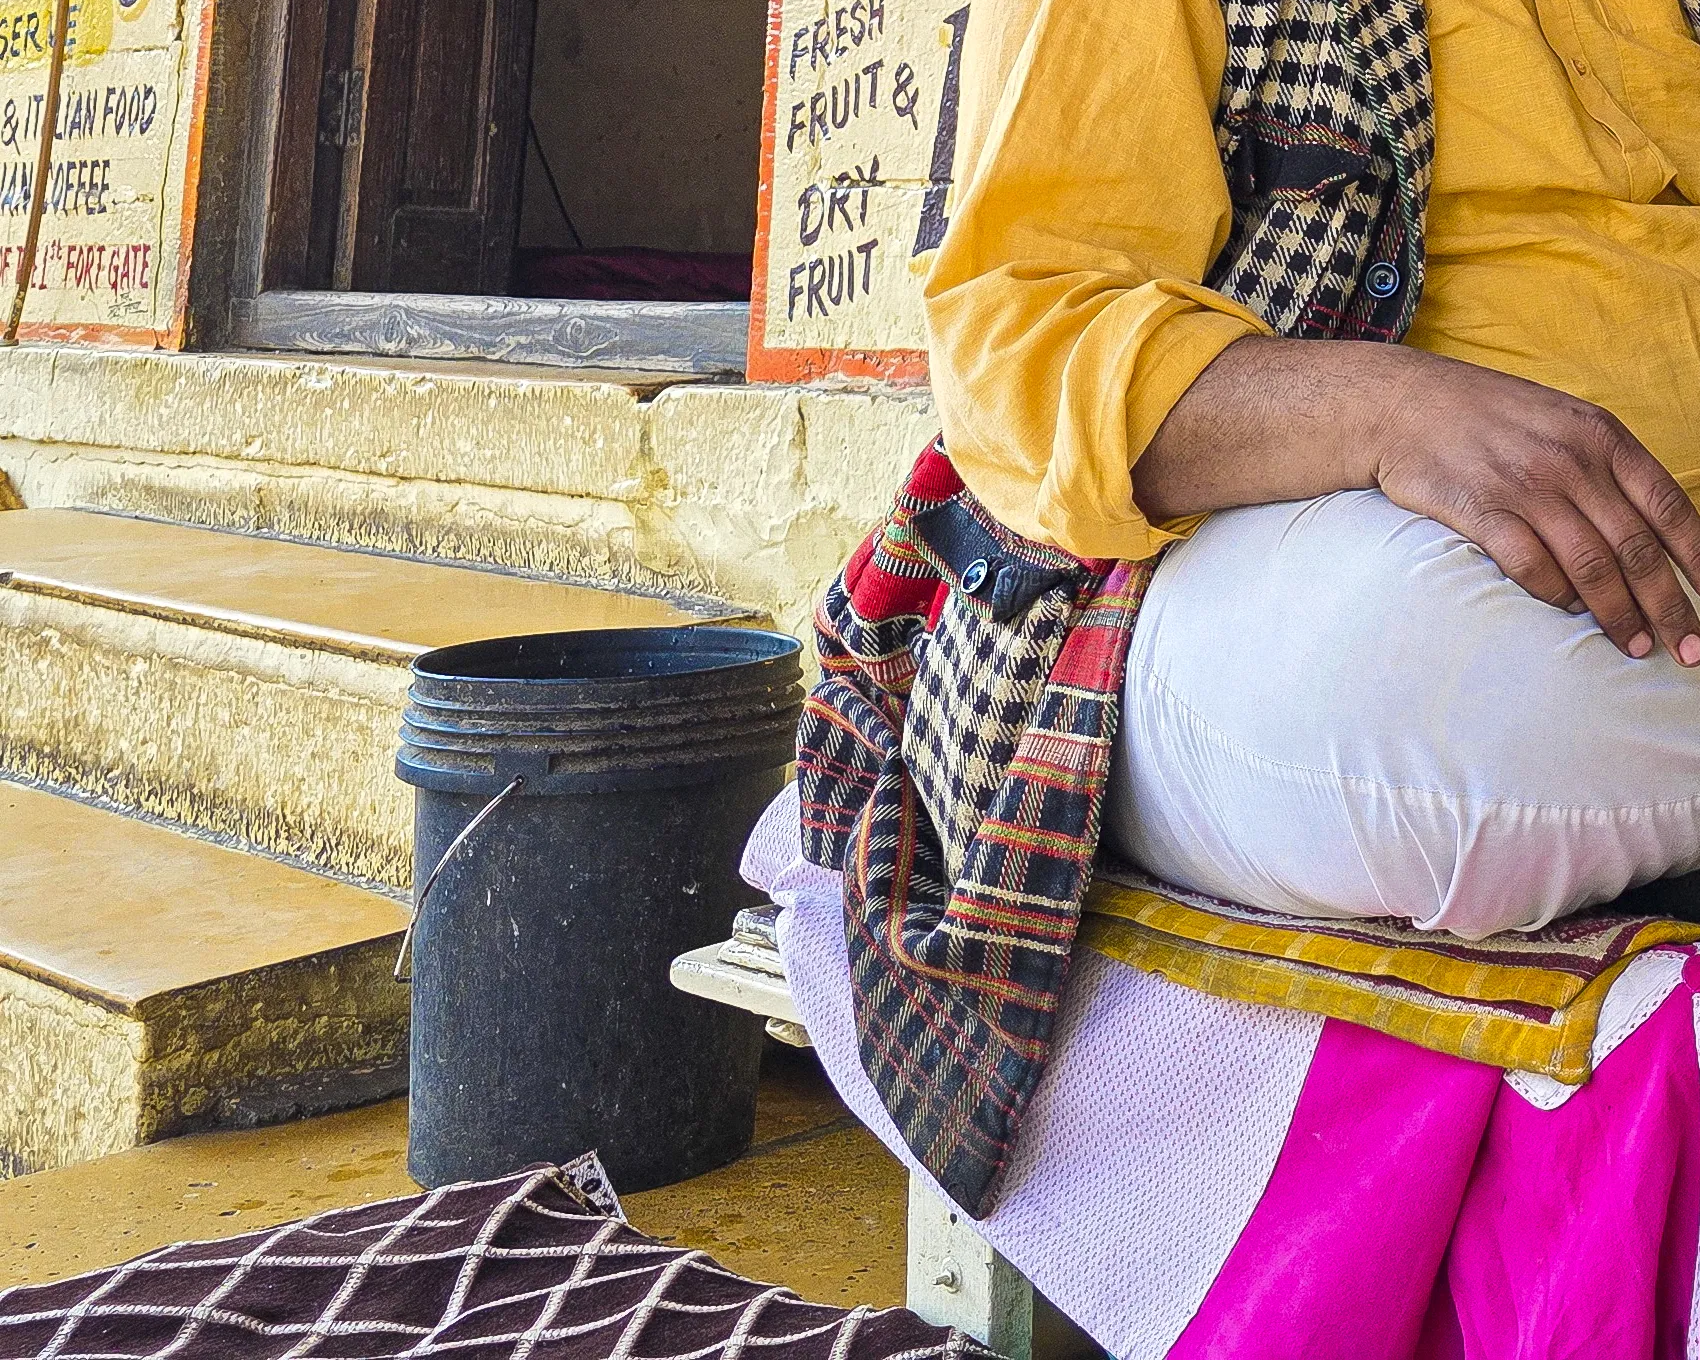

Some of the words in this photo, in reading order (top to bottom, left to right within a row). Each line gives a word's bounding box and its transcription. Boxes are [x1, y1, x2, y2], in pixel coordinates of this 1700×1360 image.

[0, 4, 80, 60] SERE
[1, 98, 20, 155] &
[24, 88, 97, 140] ITLIAN
[102, 84, 157, 137] FOOD
[787, 58, 883, 153] FRUIT
[894, 62, 920, 130] &
[799, 156, 880, 247] DRY
[64, 244, 106, 293] FORT
[108, 243, 150, 303] GATE
[788, 239, 879, 322] FRUIT
